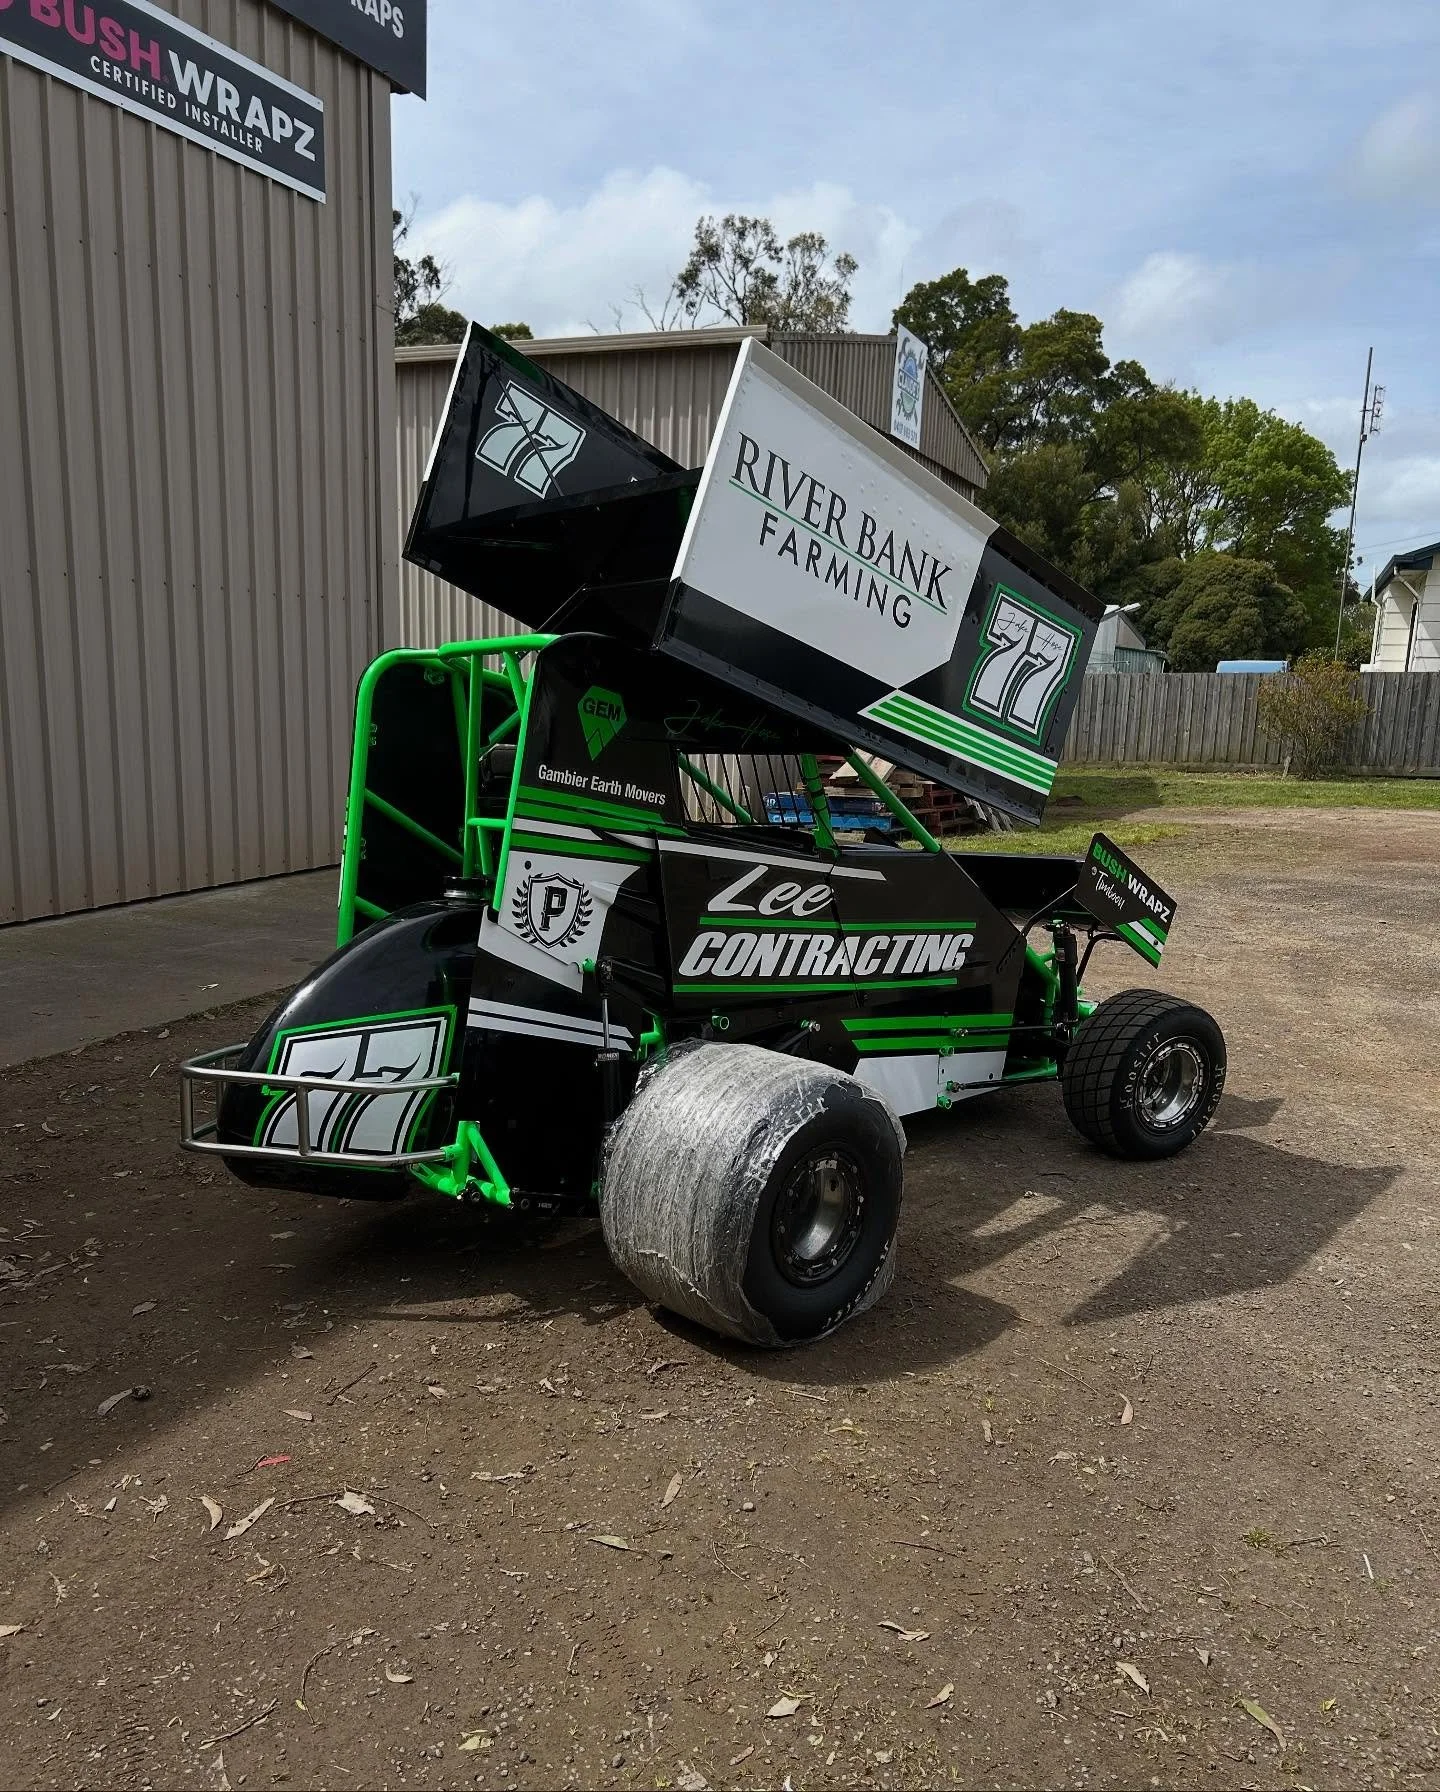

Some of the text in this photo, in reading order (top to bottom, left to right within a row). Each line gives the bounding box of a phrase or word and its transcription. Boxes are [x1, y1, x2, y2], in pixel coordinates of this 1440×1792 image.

[90, 55, 263, 154] CERTIFIED INSTALLER
[168, 49, 316, 162] WRAPZ
[475, 380, 587, 499] 77
[731, 431, 953, 610] RIVER BANK
[758, 510, 912, 629] FARMING
[583, 698, 621, 721] GEM
[969, 592, 1076, 736] 77
[538, 764, 667, 806] Gambier Earth Movers
[539, 885, 568, 932] P
[707, 864, 834, 917] Lee
[1092, 842, 1171, 923] BUSH WRAPZ
[678, 931, 975, 978] CONTRACTING
[262, 1016, 448, 1155] 77
